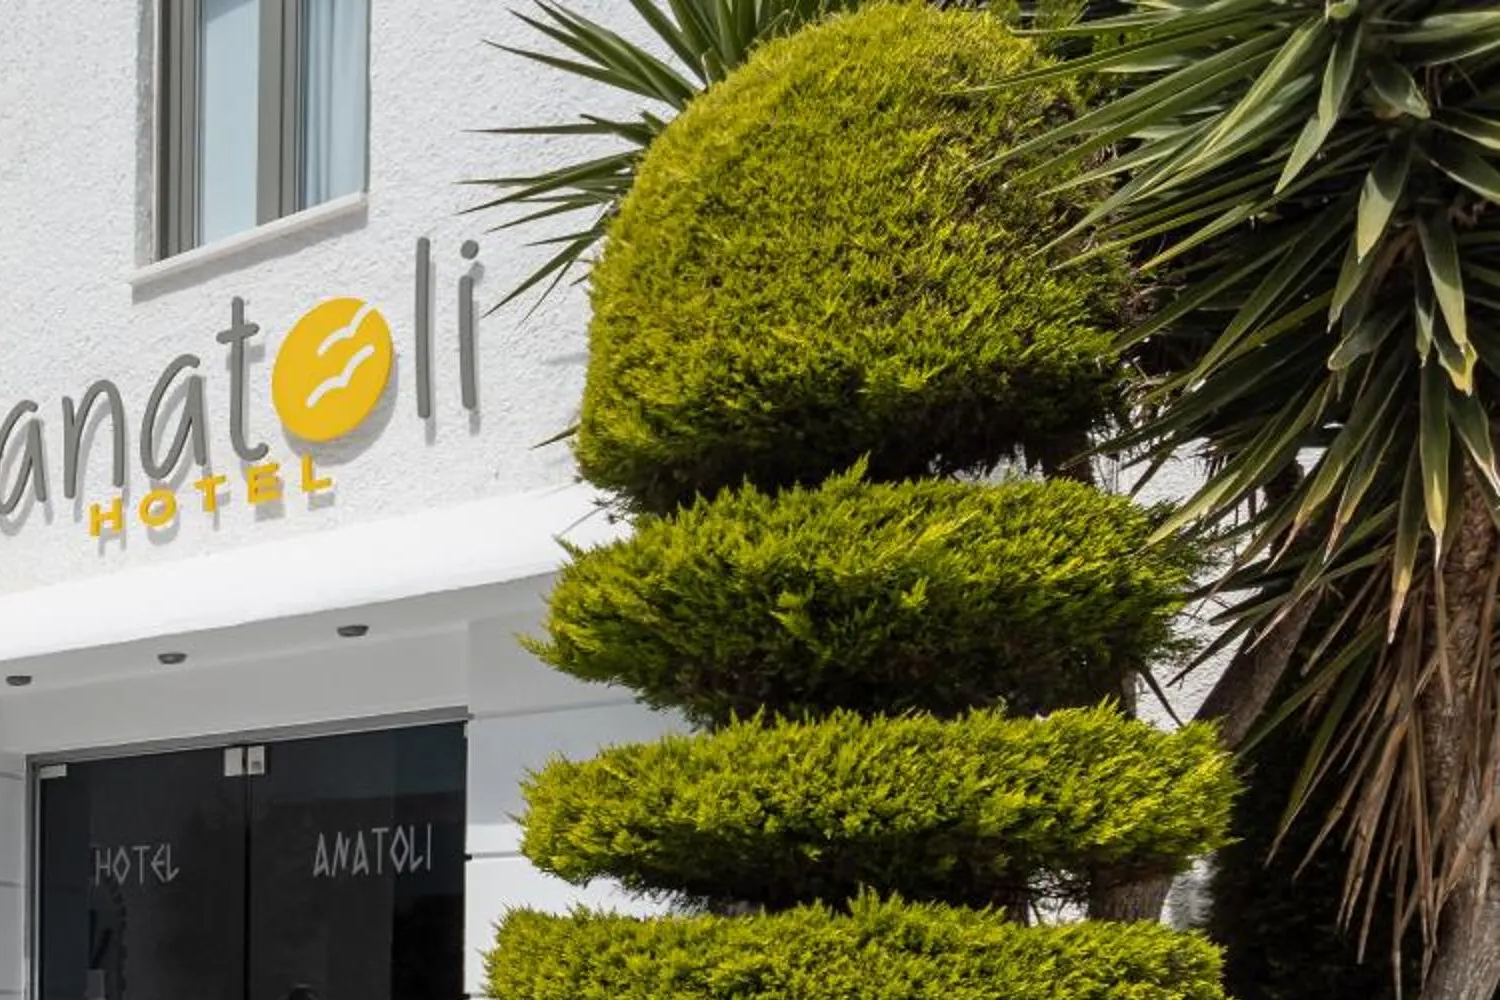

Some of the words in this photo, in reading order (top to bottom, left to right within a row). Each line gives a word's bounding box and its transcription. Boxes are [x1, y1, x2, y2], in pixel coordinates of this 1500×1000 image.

[89, 454, 332, 537] HOTEL
[94, 844, 180, 886] HOTEL
[312, 823, 432, 878] ANATOLI
